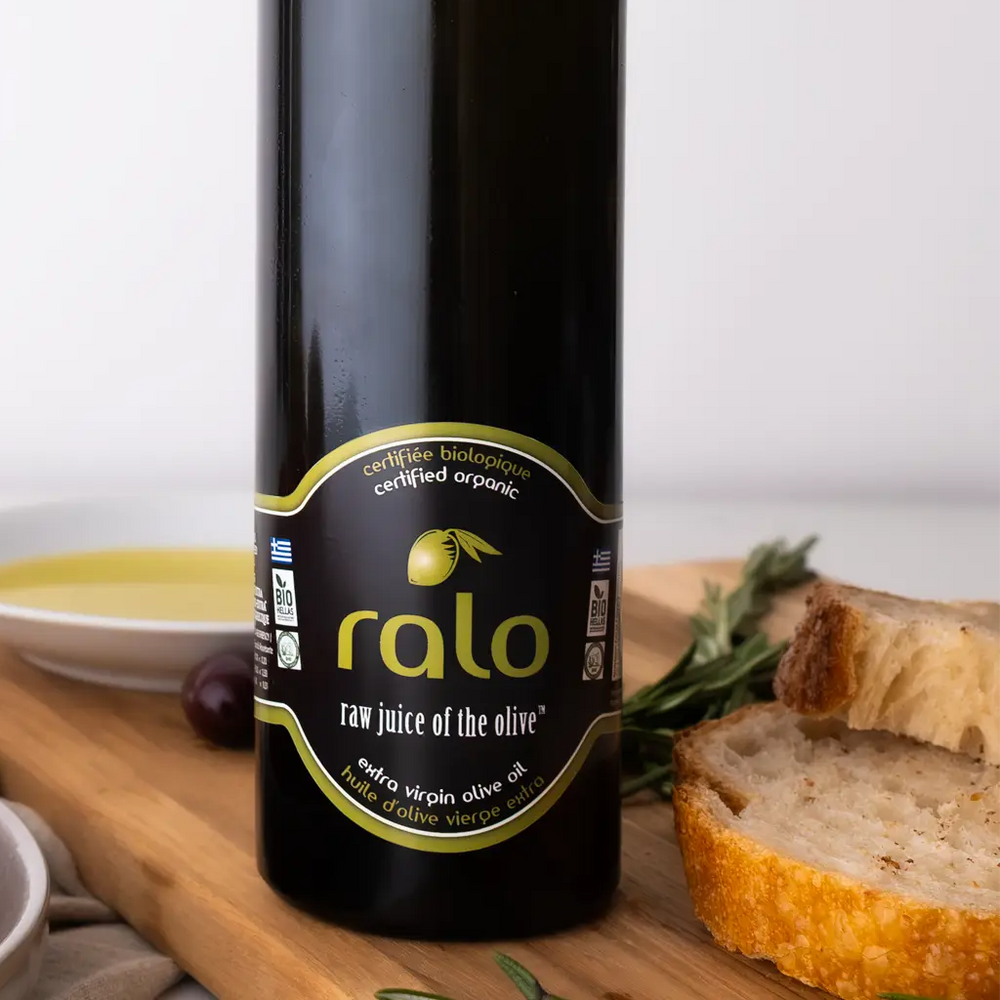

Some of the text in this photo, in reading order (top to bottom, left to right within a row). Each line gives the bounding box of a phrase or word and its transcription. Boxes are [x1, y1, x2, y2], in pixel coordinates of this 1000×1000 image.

[363, 445, 531, 480] certifiée biologique
[374, 466, 520, 500] certified organic
[276, 588, 293, 607] BIO
[591, 599, 606, 618] BIO
[337, 592, 550, 680] ralo
[340, 701, 373, 730] raw
[376, 701, 425, 736] juice
[432, 706, 453, 737] of
[458, 707, 488, 738] the
[340, 765, 545, 826] huile d'olive vierge extra
[358, 757, 528, 807] extra virgin olive oil
